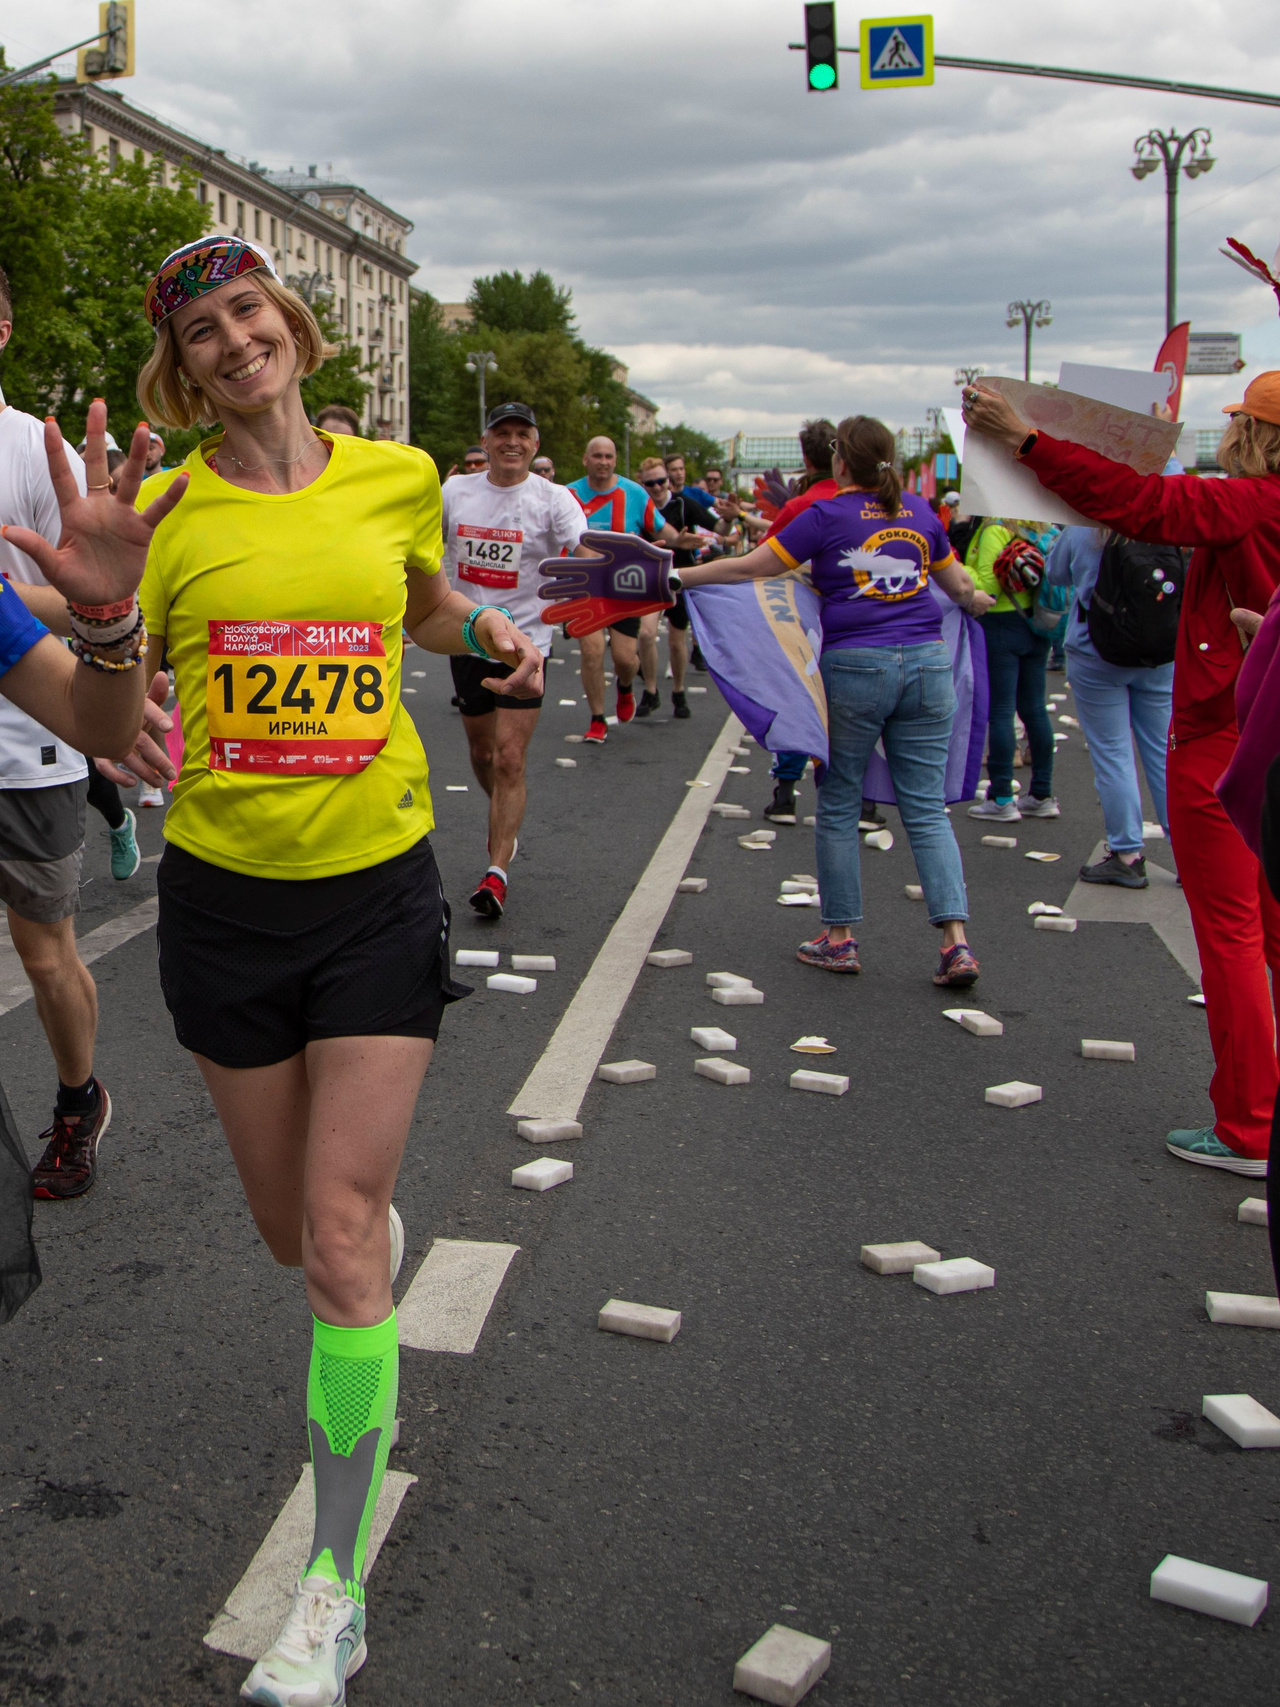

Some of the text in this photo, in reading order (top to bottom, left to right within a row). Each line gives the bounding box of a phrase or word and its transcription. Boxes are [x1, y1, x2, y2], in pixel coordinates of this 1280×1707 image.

[465, 540, 514, 563] 1482
[224, 643, 272, 651] МАРАФОН
[348, 644, 370, 652] 2023
[213, 663, 385, 715] 12478
[268, 721, 329, 735] ИРИНА
[223, 742, 242, 769] F
